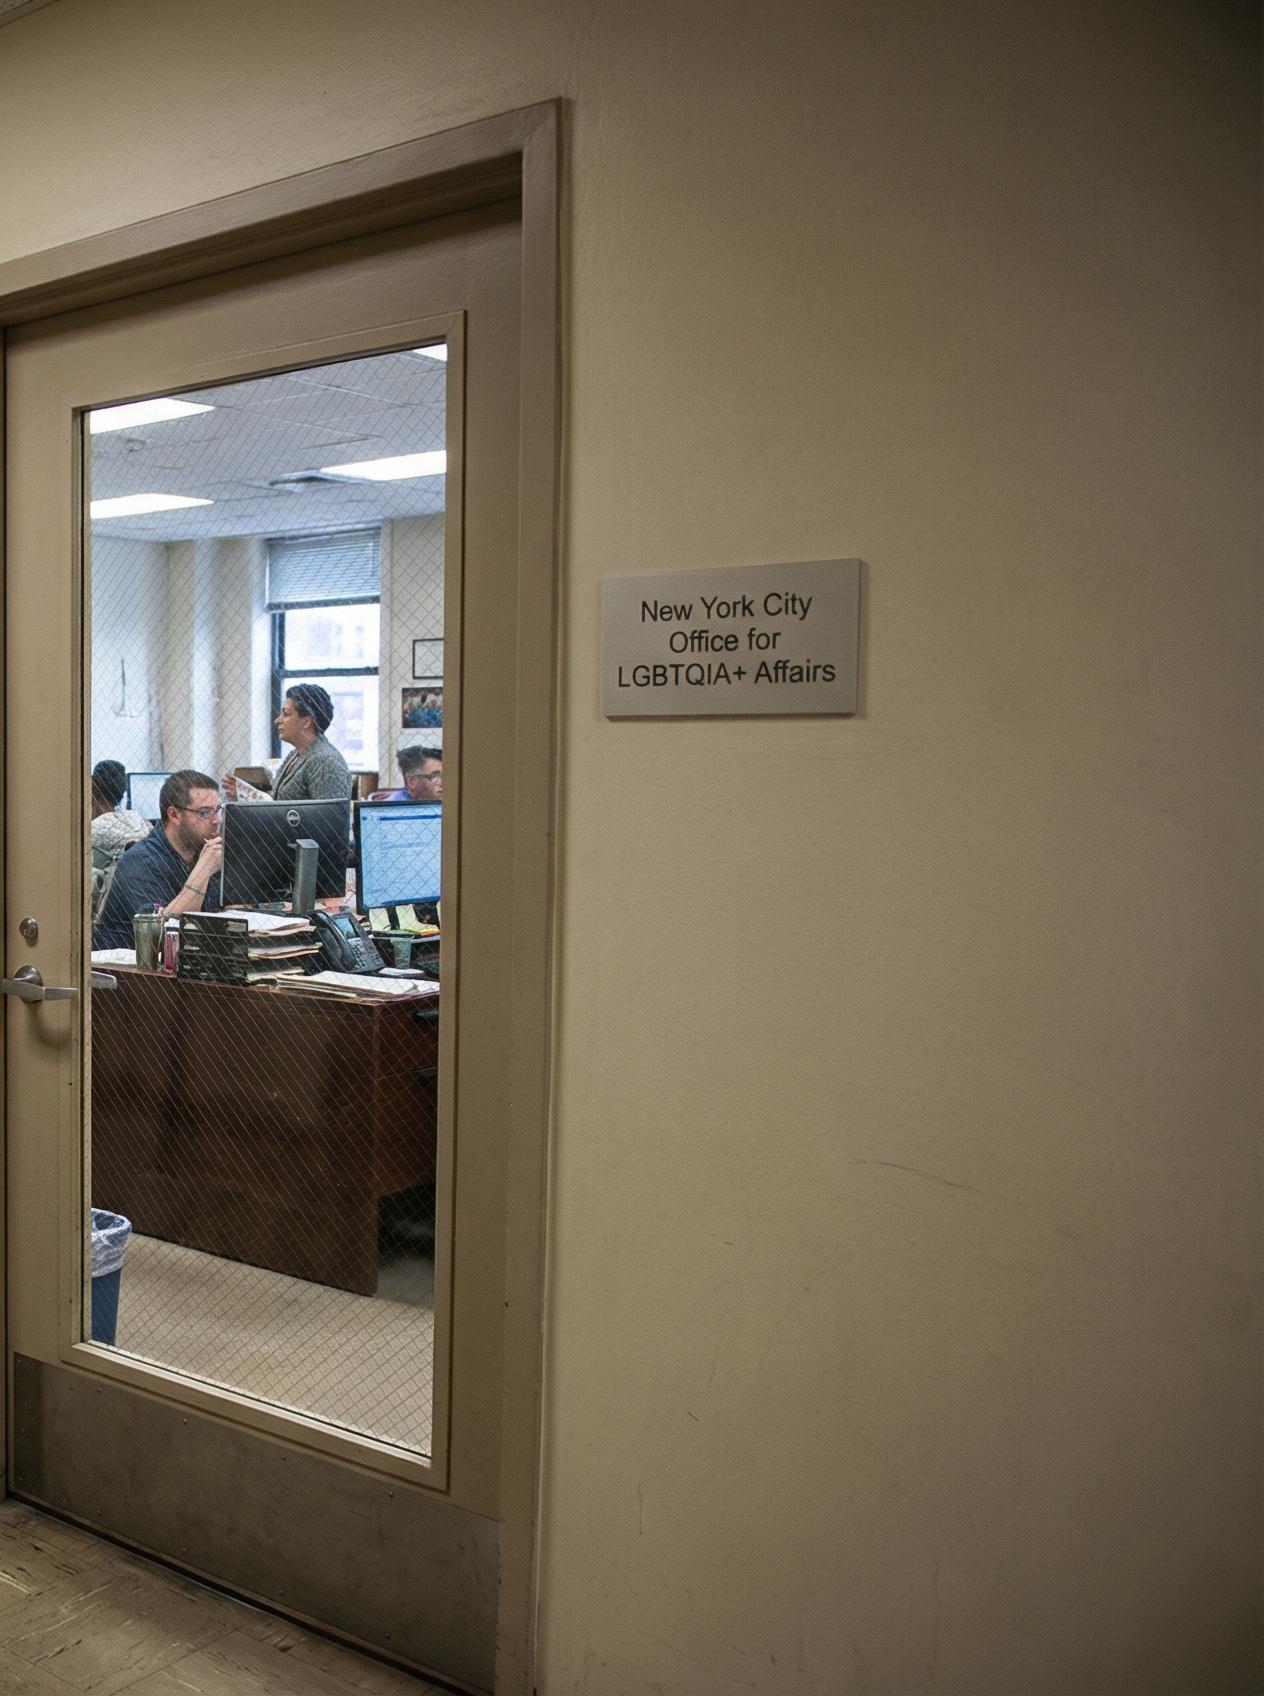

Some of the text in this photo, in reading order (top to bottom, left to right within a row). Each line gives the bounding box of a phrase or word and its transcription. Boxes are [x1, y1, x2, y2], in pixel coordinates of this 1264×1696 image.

[641, 592, 813, 622] New York City
[669, 628, 781, 653] Office for
[617, 659, 836, 687] LGBTQIA+ Affairs
